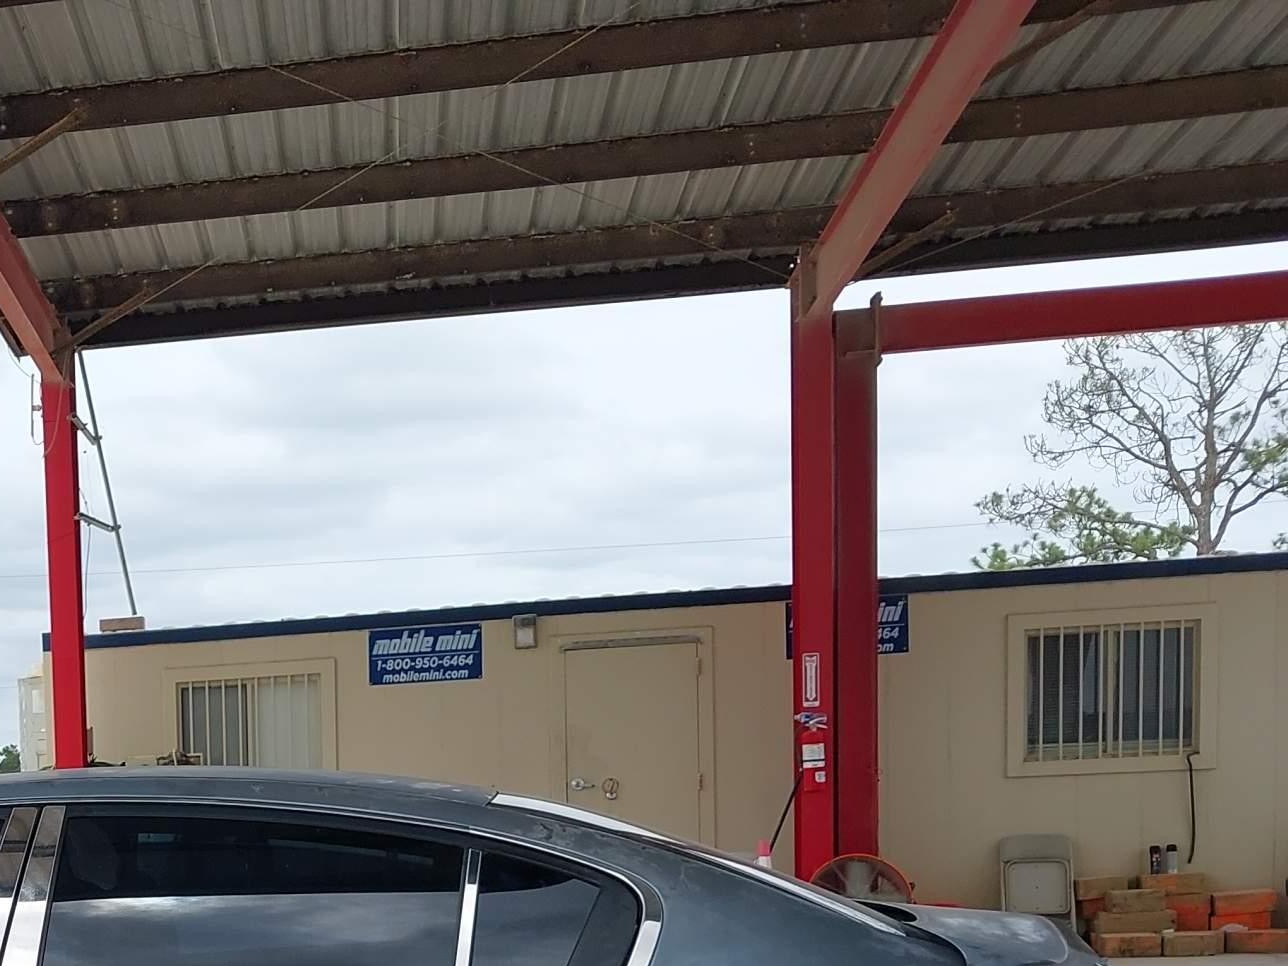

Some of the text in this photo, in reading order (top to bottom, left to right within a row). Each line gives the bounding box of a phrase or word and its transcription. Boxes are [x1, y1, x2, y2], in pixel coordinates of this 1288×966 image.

[372, 629, 480, 655] mobile mini
[376, 654, 473, 672] 1-800-950-6464
[382, 669, 469, 683] mobilemini.com
